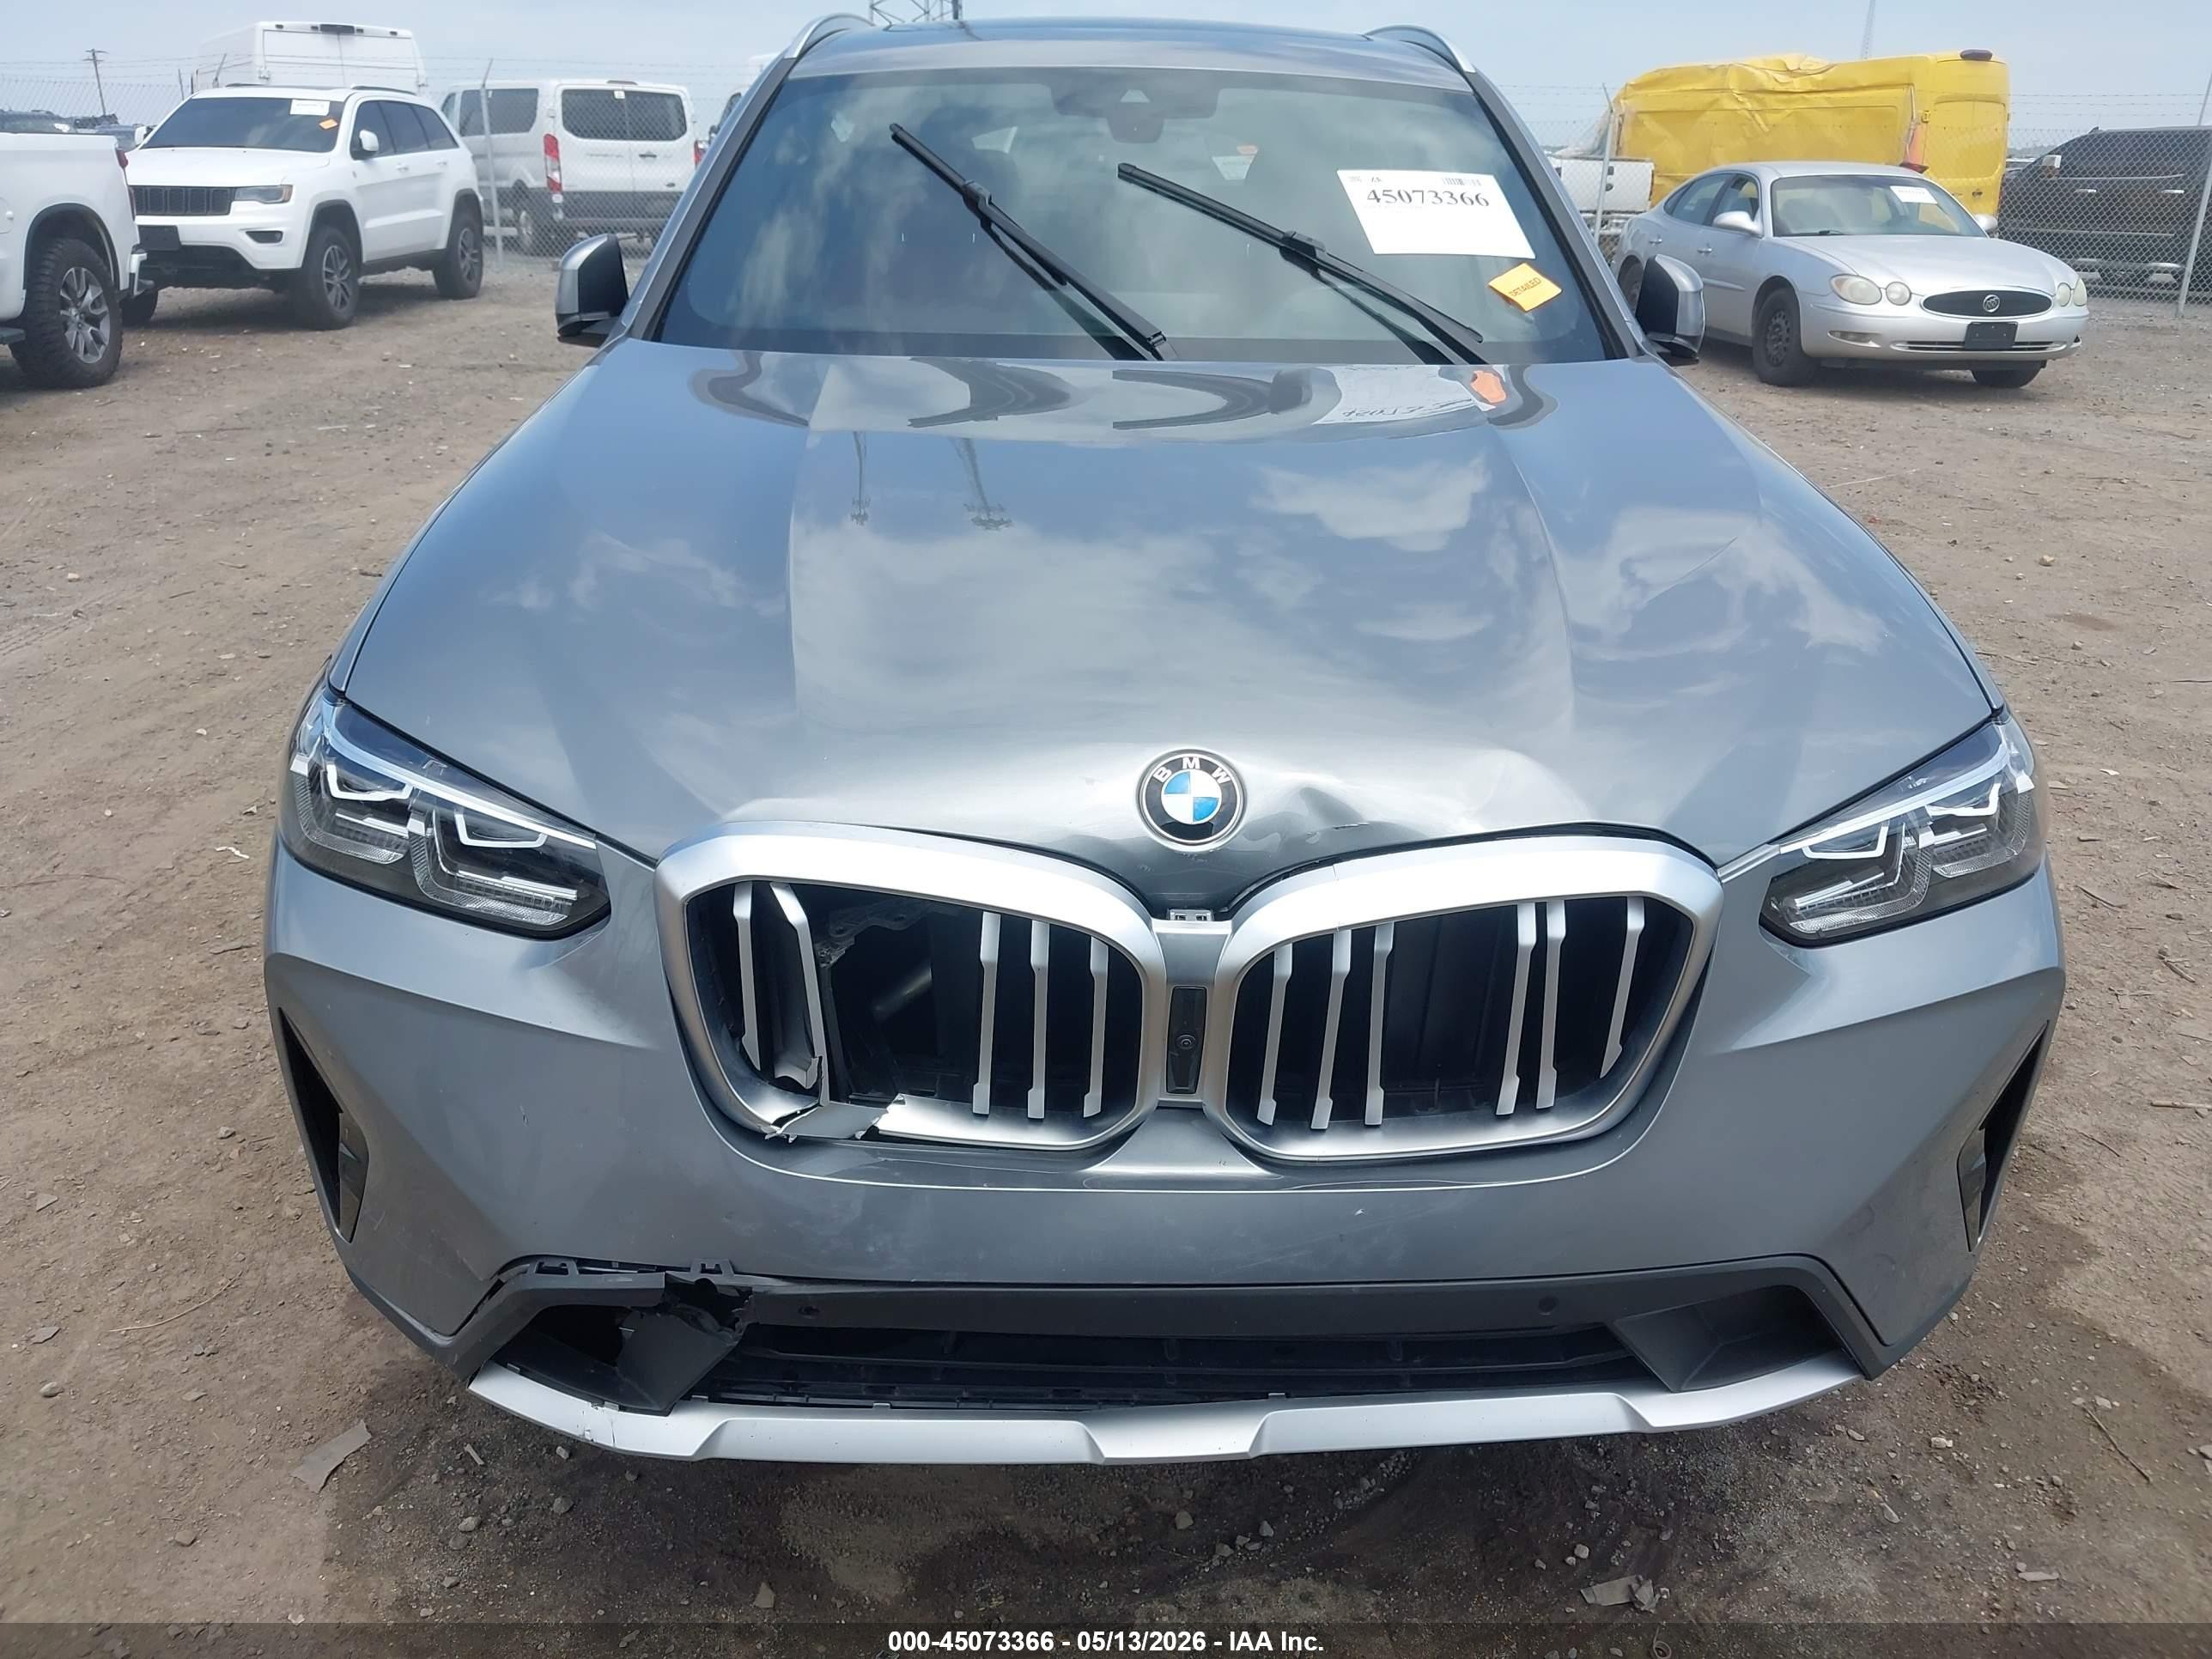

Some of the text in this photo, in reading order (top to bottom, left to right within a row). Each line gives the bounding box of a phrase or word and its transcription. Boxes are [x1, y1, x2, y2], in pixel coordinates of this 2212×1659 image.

[1367, 189, 1490, 207] 45073366
[1508, 276, 1542, 297] DETAILED
[1152, 757, 1231, 784] BMW
